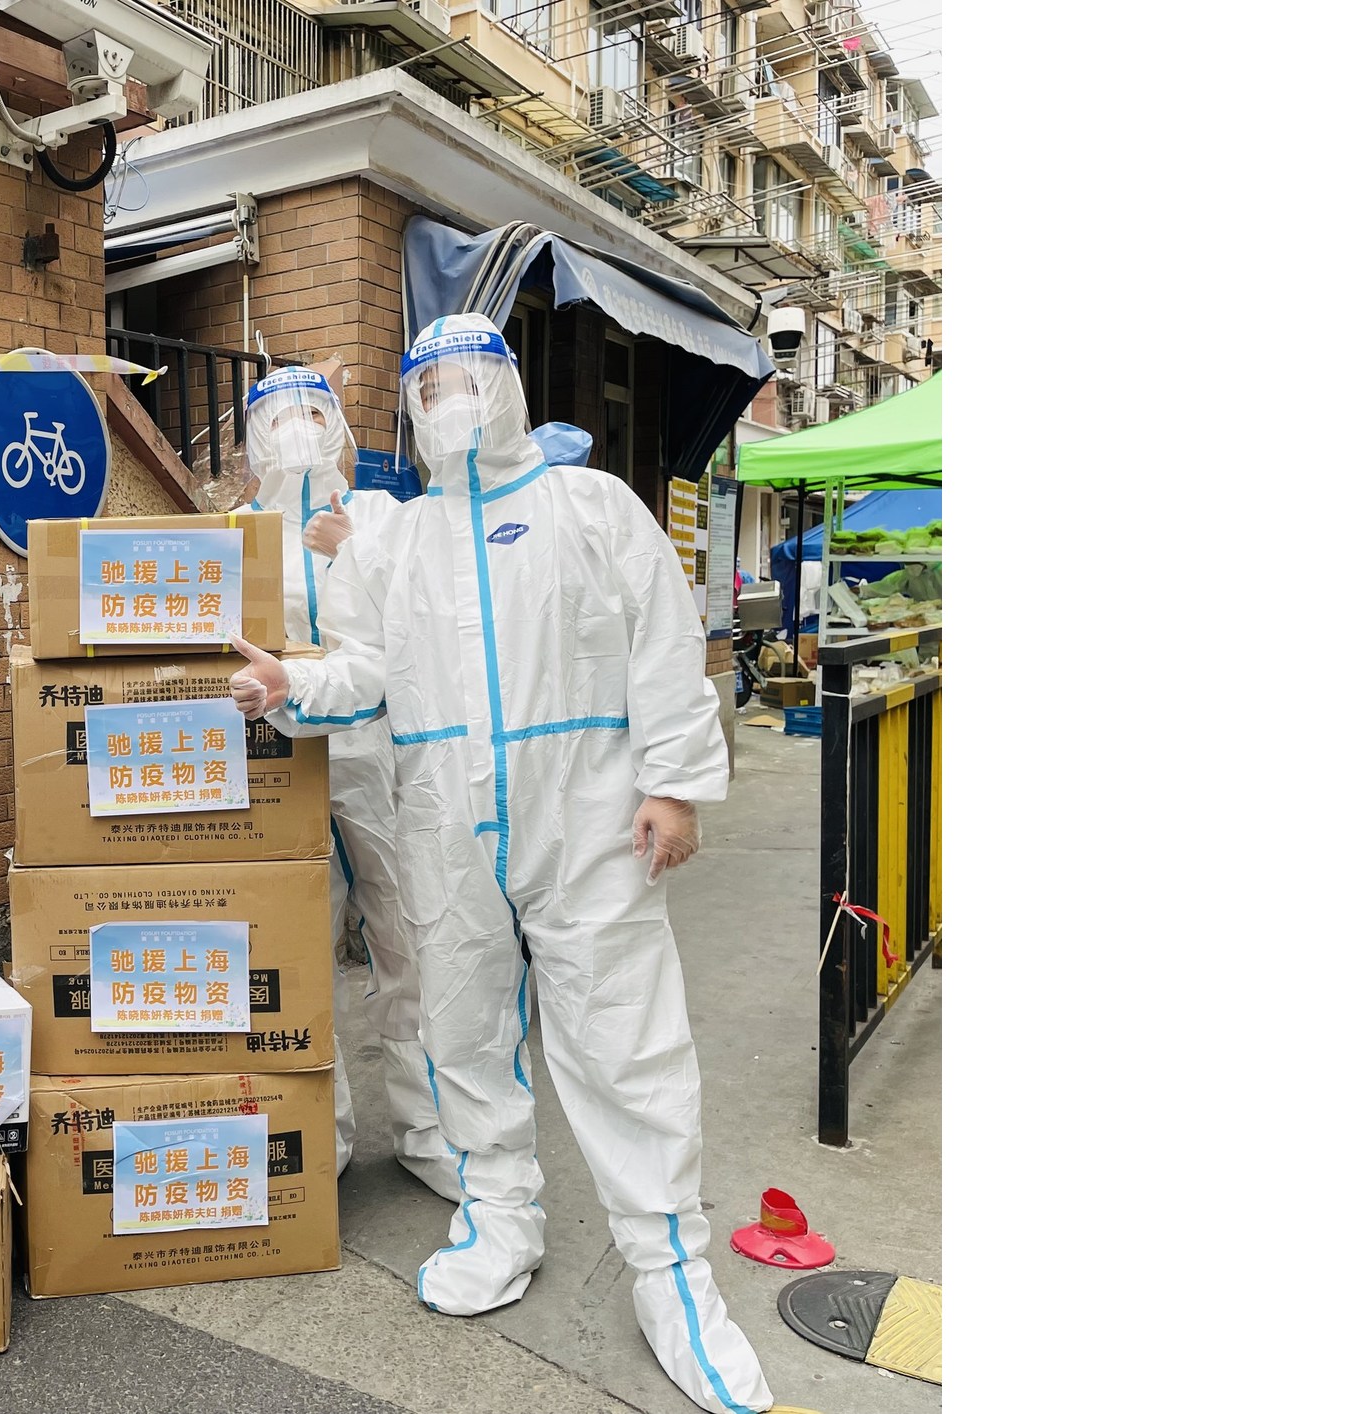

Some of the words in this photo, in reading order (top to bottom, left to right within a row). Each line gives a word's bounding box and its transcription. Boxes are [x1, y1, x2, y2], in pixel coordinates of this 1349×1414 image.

[416, 340, 441, 355] Face
[446, 334, 482, 344] shield
[262, 376, 283, 388] Face
[287, 373, 316, 381] shield
[101, 559, 223, 584] 驰援上海
[101, 592, 222, 618] 防疫物资
[106, 622, 188, 633] 陈晓陈妍希夫妇
[191, 622, 215, 633] 捐赠
[39, 684, 104, 707] 乔特迪
[107, 727, 227, 757] 驰援上海
[109, 759, 228, 789] 防疫物资
[115, 790, 195, 804] 陈晓陈妍希夫妇
[199, 788, 222, 800] 捐赠
[111, 822, 253, 834] 泰兴市乔特迪服饰有限公司
[112, 890, 153, 898] CLOTHING
[157, 889, 197, 897] QIAOTEDI
[200, 888, 236, 896] TAIXING
[84, 898, 227, 911] 泰兴市乔特迪服饰有限公司
[110, 948, 230, 973] 驰援上海
[112, 981, 230, 1005] 防疫物资
[117, 1009, 197, 1021] 陈晓陈妍希夫妇
[200, 1009, 224, 1021] 捐赠
[246, 1028, 311, 1052] 乔特迪
[51, 1107, 116, 1136] 乔特迪
[134, 1145, 250, 1175] 驰援上海
[134, 1177, 250, 1208] 防疫物资
[139, 1207, 217, 1223] 陈晓陈妍希夫妇
[221, 1205, 243, 1218] 捐赠
[132, 1238, 271, 1261] 泰兴市乔特迪服饰有限公司
[124, 1261, 158, 1270] TAIXING
[161, 1257, 200, 1267] QIAOTEDI
[204, 1252, 244, 1262] CLOTHING
